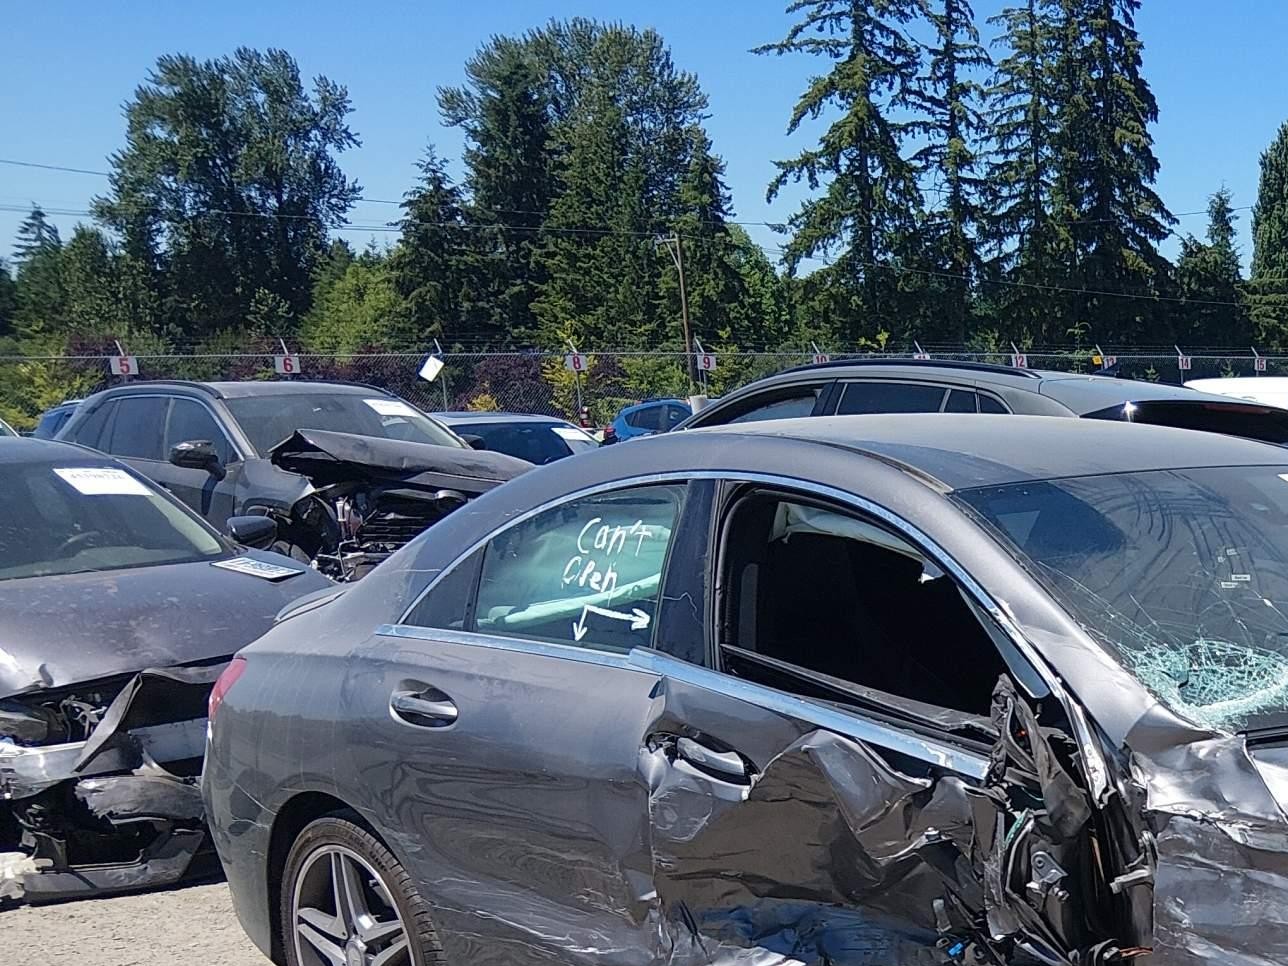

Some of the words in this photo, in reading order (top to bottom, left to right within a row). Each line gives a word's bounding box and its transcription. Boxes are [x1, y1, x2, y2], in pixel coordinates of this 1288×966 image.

[118, 357, 130, 374] 5
[282, 357, 293, 373] 6
[572, 356, 581, 369] 8
[703, 356, 711, 369] 9
[1014, 356, 1026, 368] 12
[1181, 358, 1190, 369] 14
